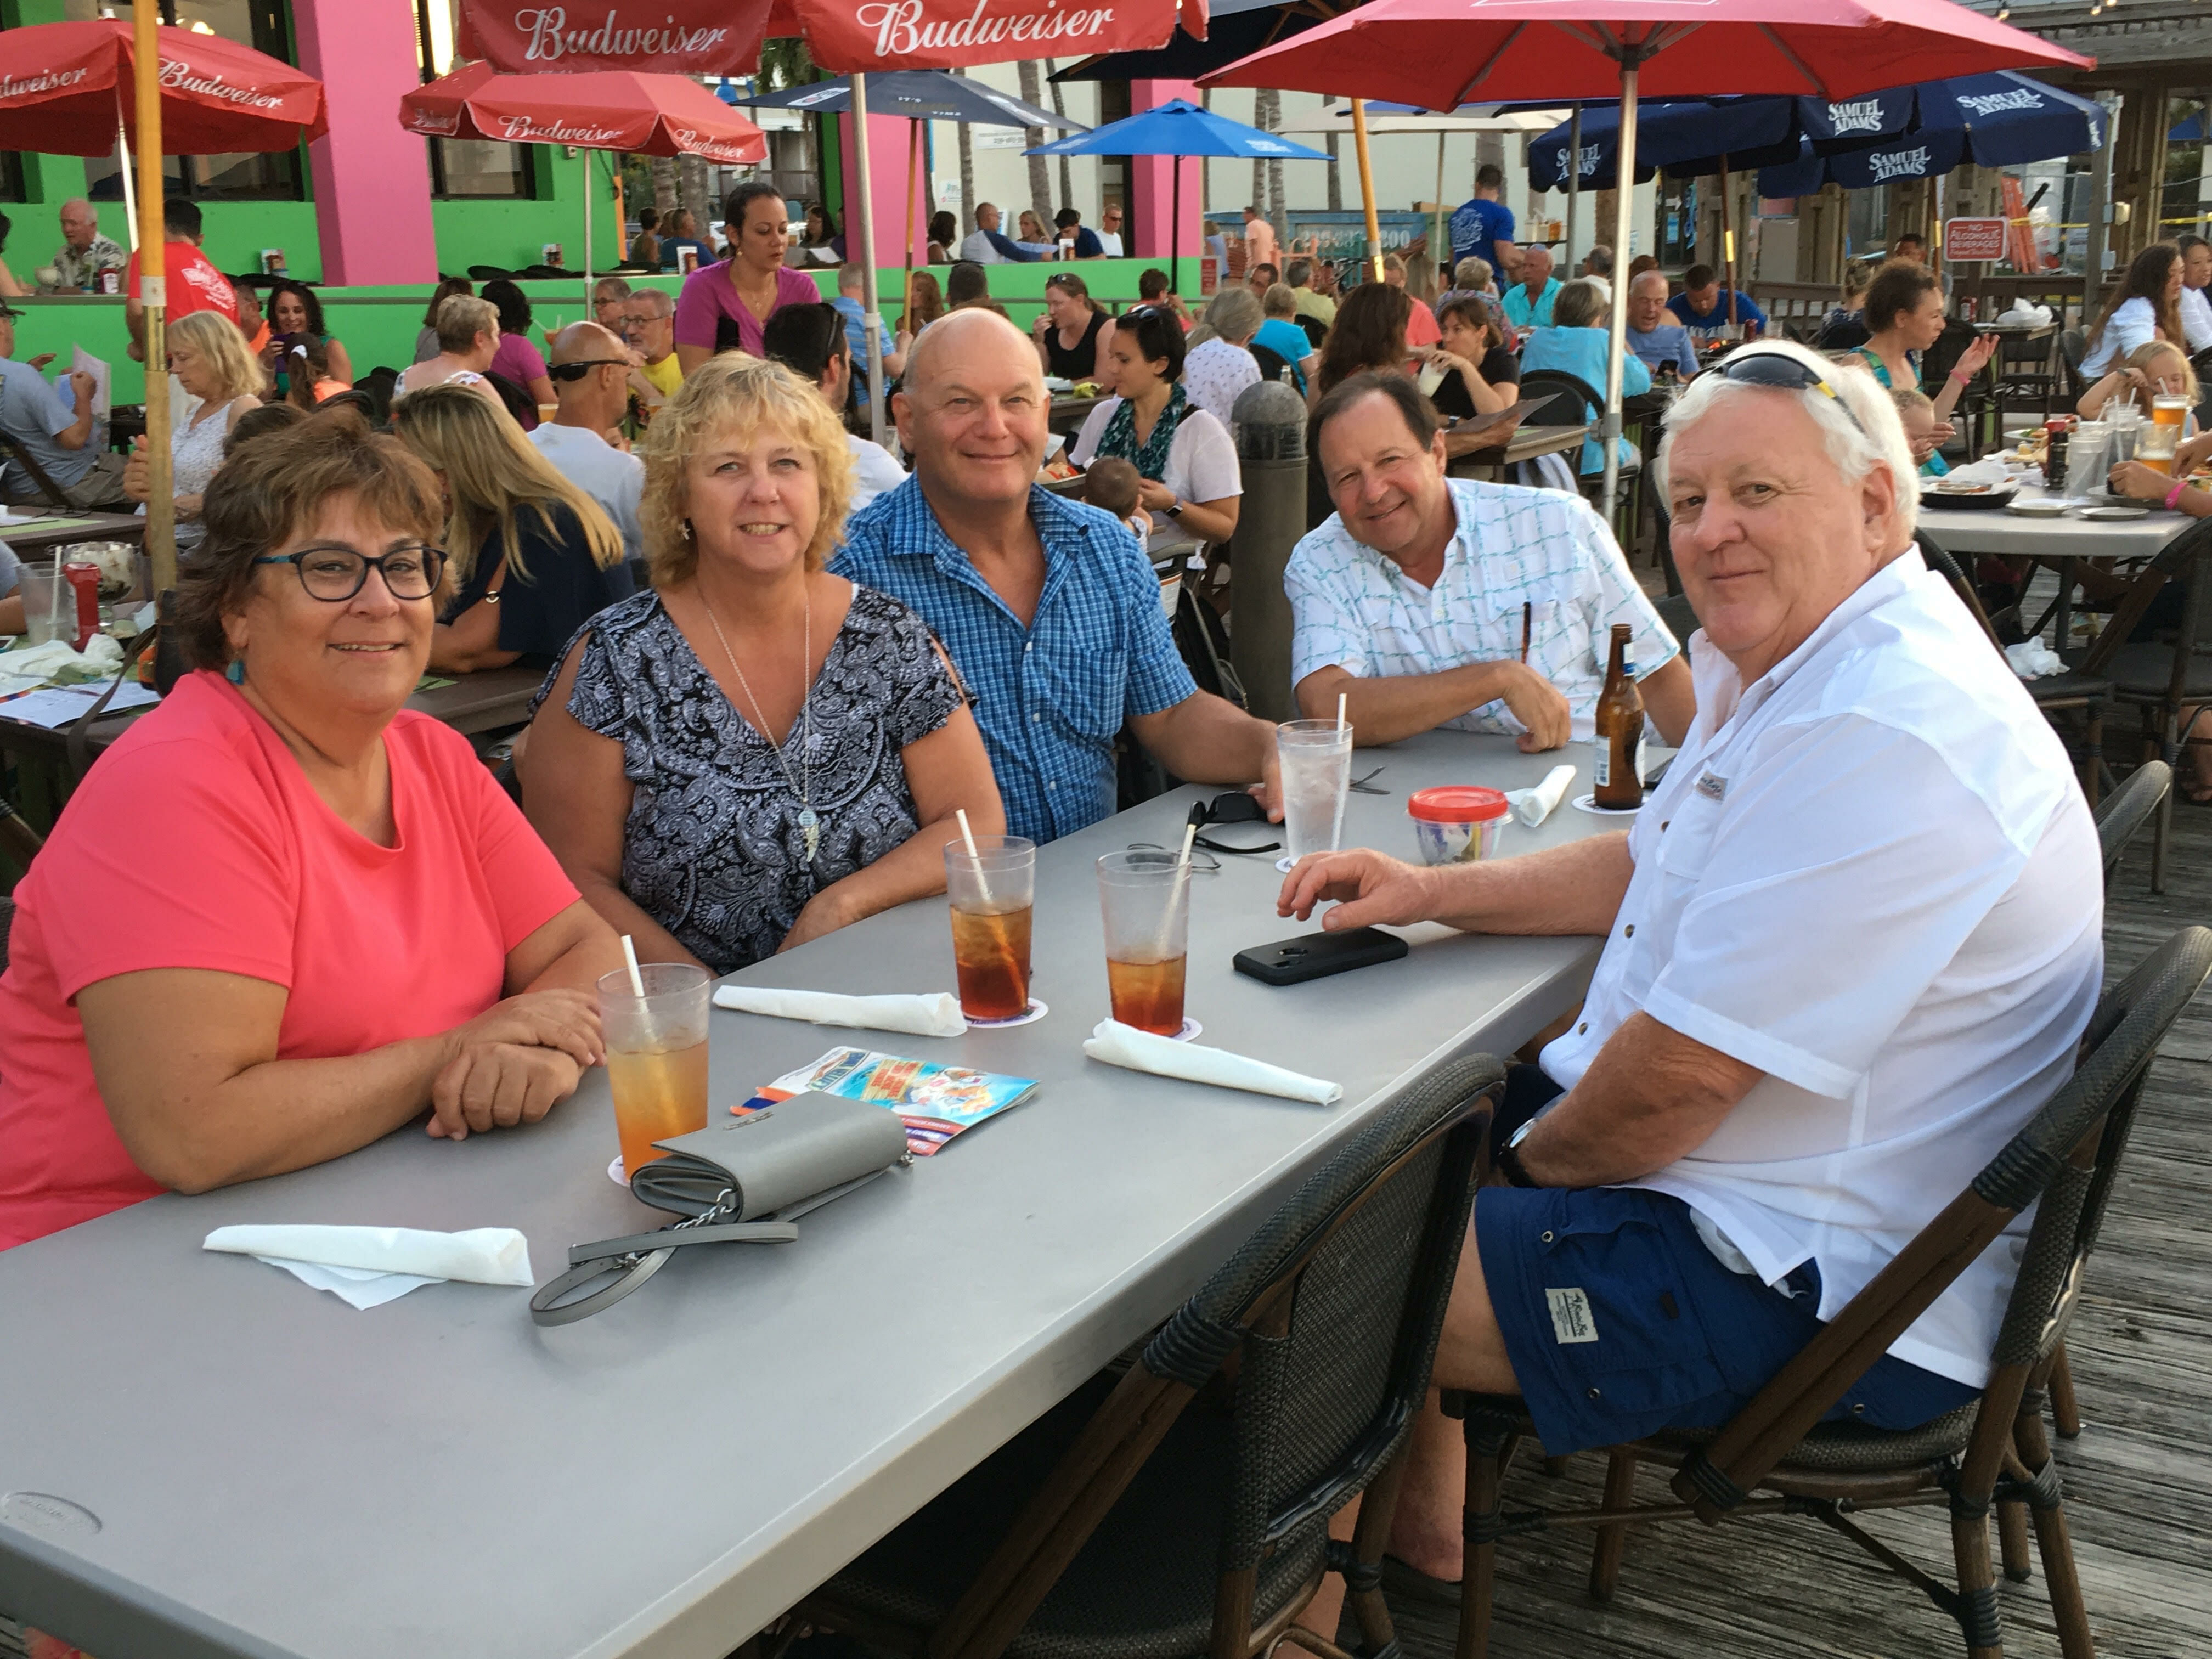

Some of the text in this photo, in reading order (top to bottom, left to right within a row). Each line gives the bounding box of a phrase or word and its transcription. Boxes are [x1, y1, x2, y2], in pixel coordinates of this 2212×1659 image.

[515, 7, 728, 61] Budweiser
[856, 0, 1114, 57] Budweiser
[158, 58, 283, 109] Budweiser
[1956, 88, 2042, 108] SAMUEL
[1975, 101, 2045, 117] ADAMS
[1828, 99, 1884, 121] SAMUEL
[498, 116, 624, 142] Budweiser
[1834, 115, 1882, 137] ADAMS
[1869, 145, 1932, 170] SAMUEL
[1872, 161, 1927, 183] ADAMS
